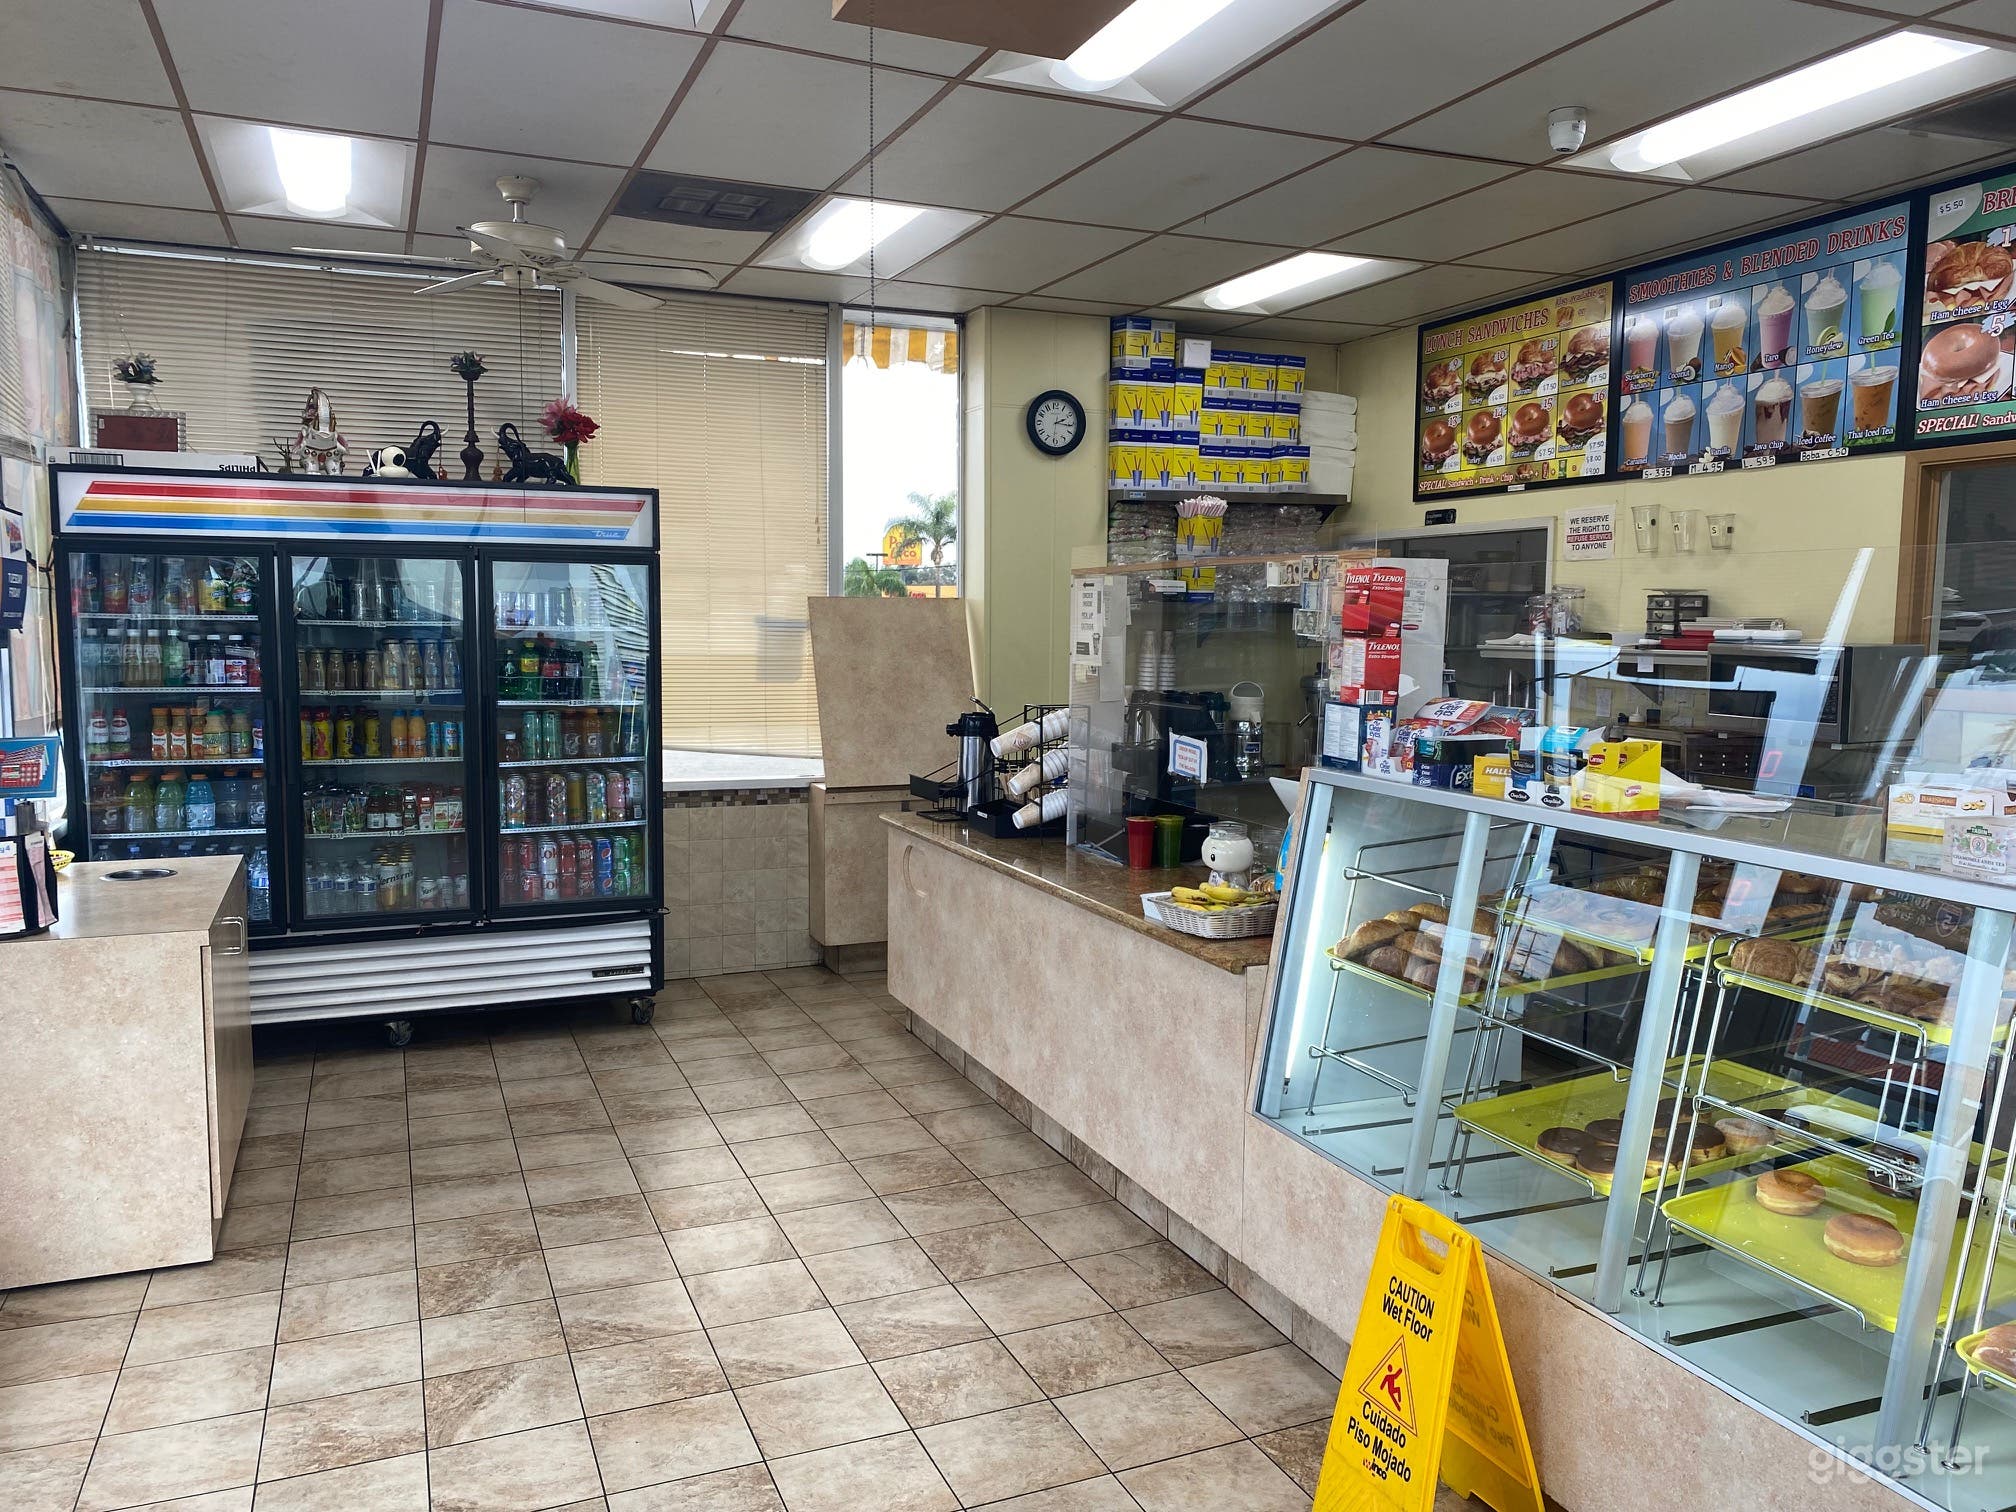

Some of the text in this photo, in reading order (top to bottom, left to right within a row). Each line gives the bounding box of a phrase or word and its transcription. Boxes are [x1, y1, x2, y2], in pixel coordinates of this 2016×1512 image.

[2002, 226, 2012, 248] 1
[1629, 215, 1906, 304] SMOOTHIES & BLENDED DRINKS
[1931, 299, 2009, 321] Ham Cheese & Egg
[1425, 308, 1549, 355] LUNCH SANDWICHES
[1991, 313, 2005, 338] 5
[1857, 331, 1896, 346] Green Tea
[1806, 340, 1844, 356] Honeydew
[1764, 353, 1780, 363] Taro
[1714, 361, 1735, 373] Mango
[1625, 371, 1657, 382] Strawberry
[1667, 369, 1691, 380] Coconut
[1629, 382, 1652, 391] Banana
[1594, 388, 1605, 403] 16
[1921, 391, 1999, 409] Ham Cheese & Egg
[1543, 397, 1554, 411] 15
[1917, 413, 1980, 435] SPECIAL!
[1814, 433, 1837, 444] Coffee
[1847, 425, 1894, 440] Thai Iced Tea
[1752, 440, 1784, 452] Java Chip
[1802, 451, 1820, 461] Boba
[1581, 515, 1609, 524] RESERVE
[1582, 525, 1600, 533] RIGHT
[1581, 542, 1607, 550] ANYONE
[1346, 573, 1370, 584] TYLENOL
[1373, 573, 1404, 583] TYLENOL
[1368, 642, 1400, 651] TYLENOL
[1389, 1275, 1435, 1319] CAUTION
[1382, 1294, 1433, 1342] Wet Floor
[1362, 1400, 1407, 1449] Cuidado
[1347, 1416, 1411, 1483] Piso Mojado
